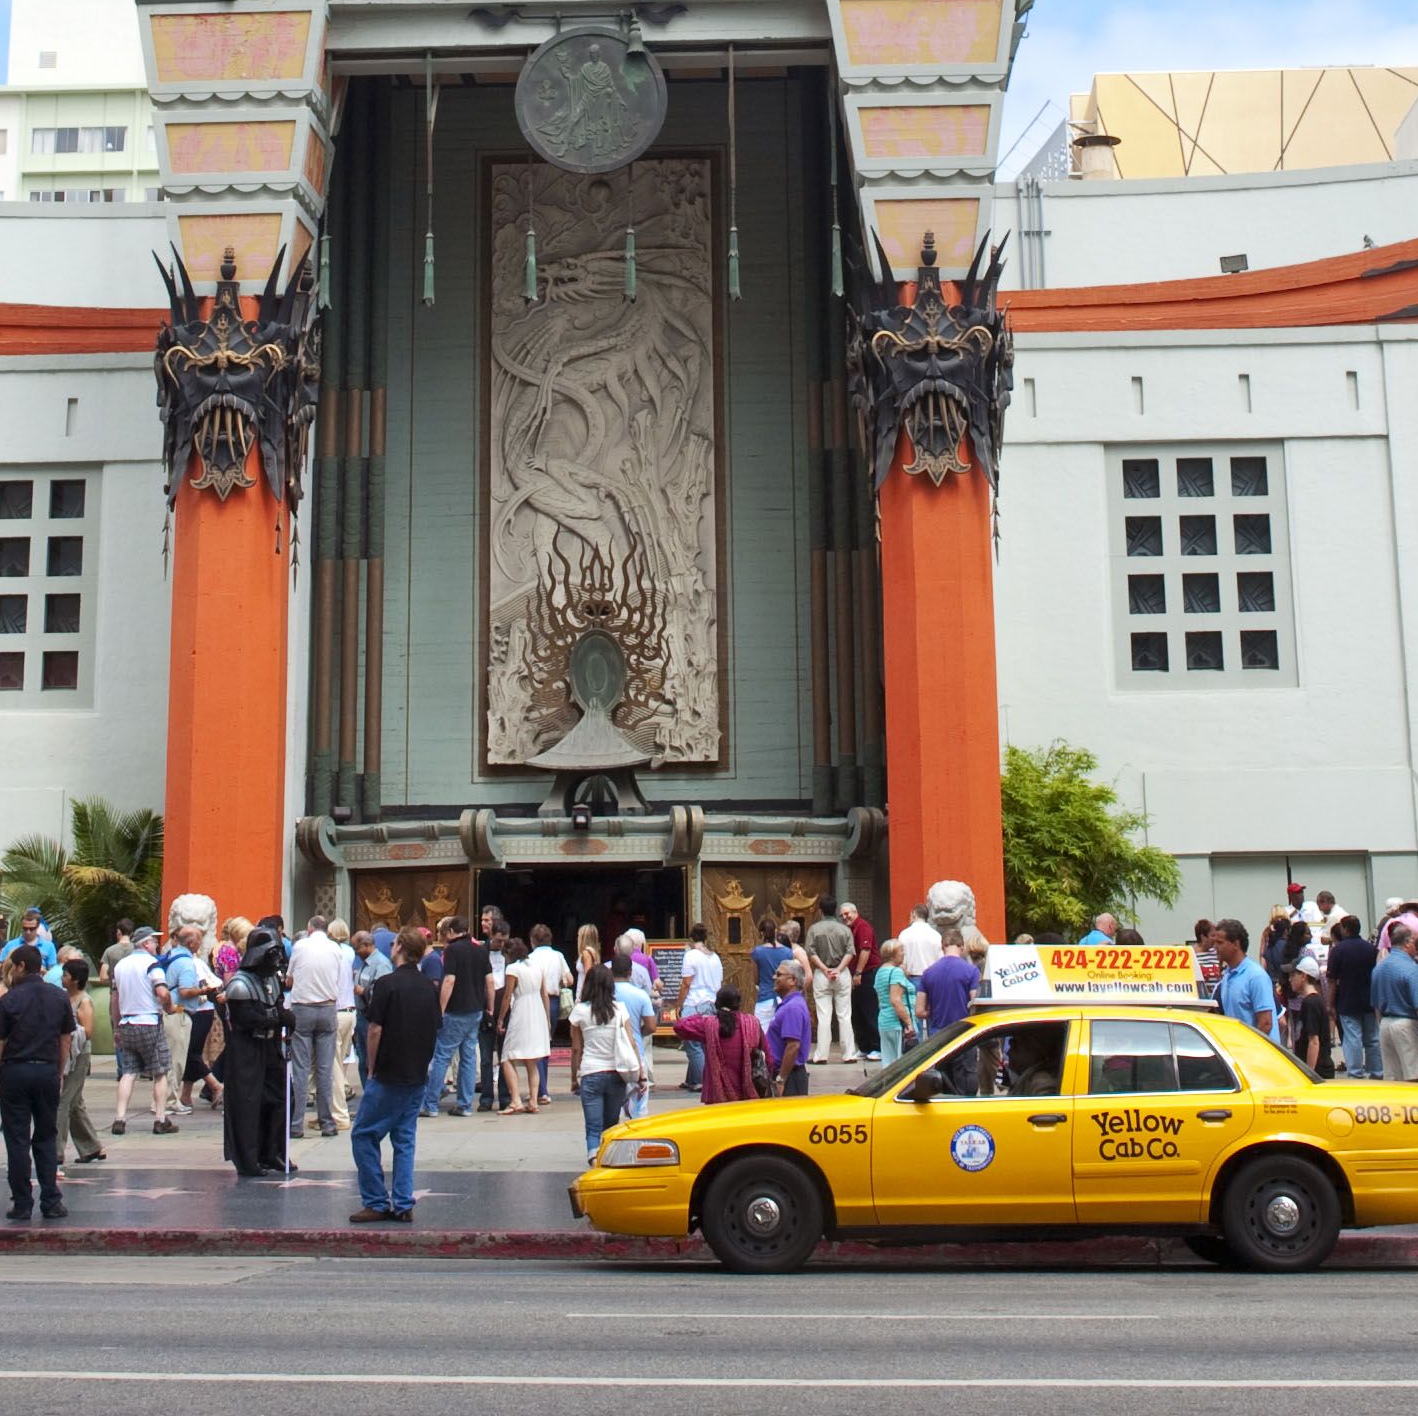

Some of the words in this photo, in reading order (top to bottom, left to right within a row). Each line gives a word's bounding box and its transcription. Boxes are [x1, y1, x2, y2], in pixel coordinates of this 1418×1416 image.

[1051, 949, 1190, 969] 424-222-2222
[993, 960, 1037, 979] Yellow
[1087, 970, 1116, 979] Online
[1002, 974, 1024, 988] Cab
[1091, 1109, 1185, 1136] Yellow
[809, 1124, 868, 1144] 6055
[1099, 1137, 1144, 1161] Cab
[1146, 1138, 1181, 1160] Co.
